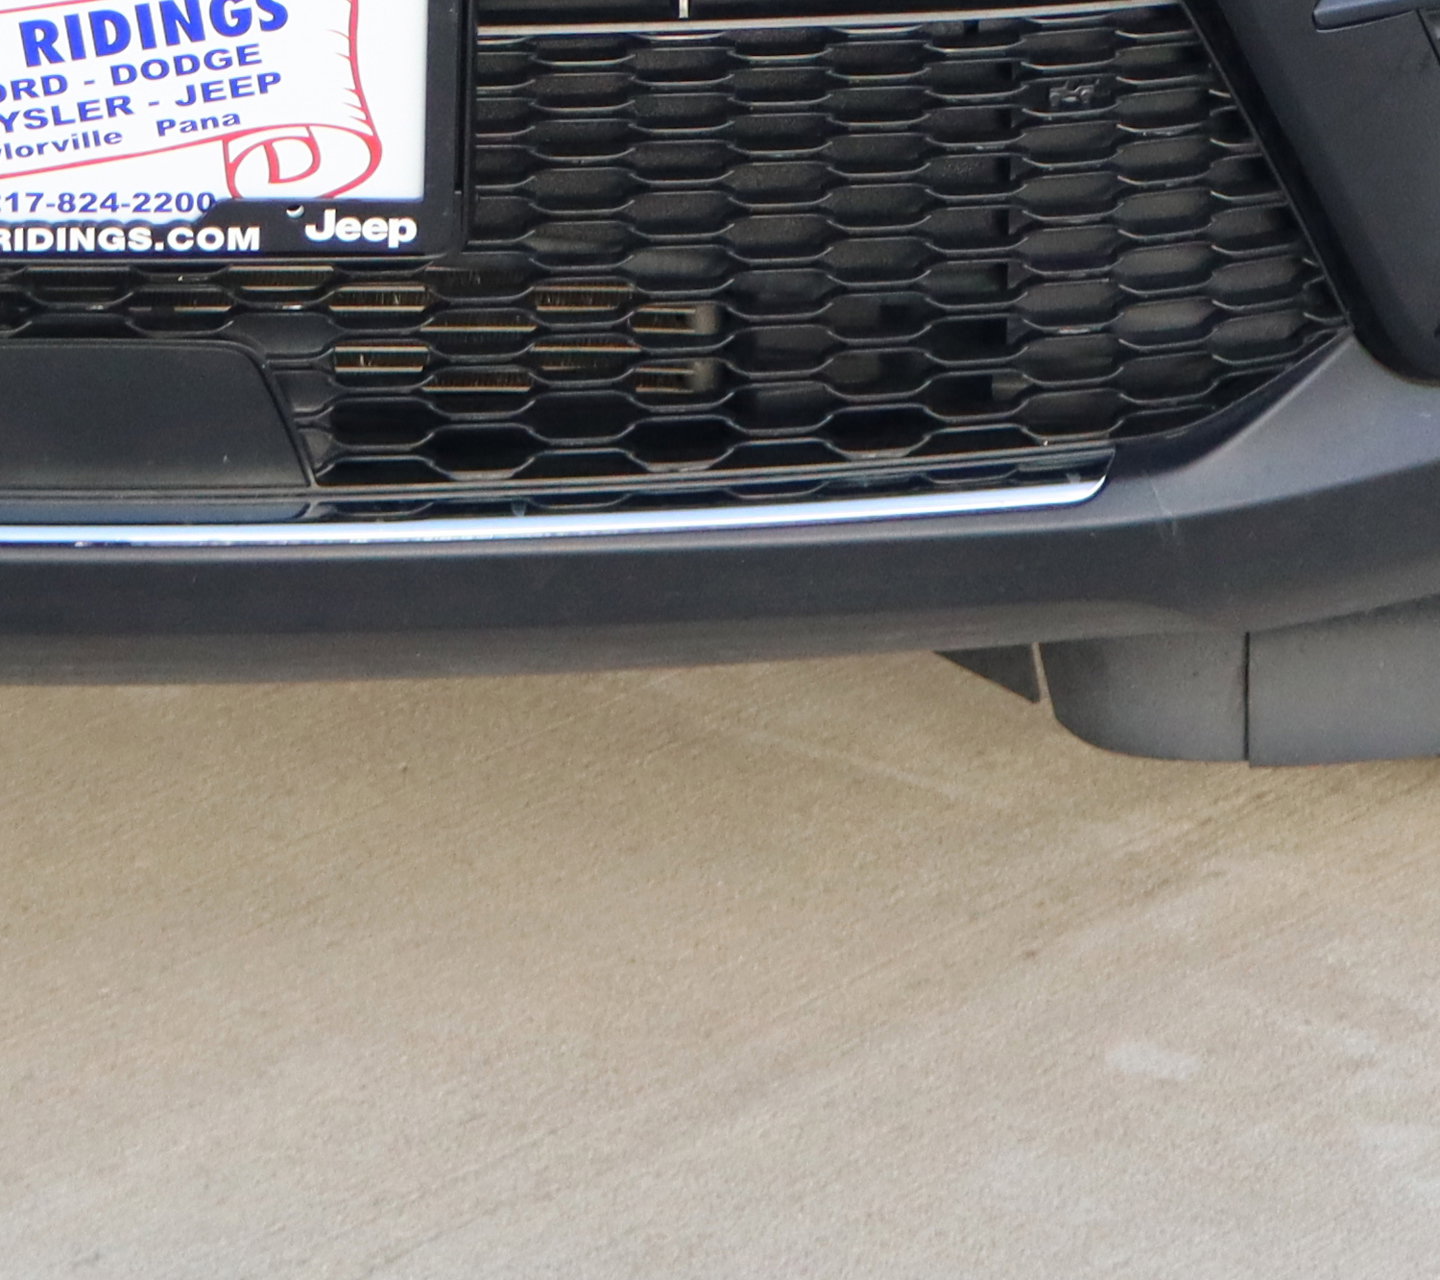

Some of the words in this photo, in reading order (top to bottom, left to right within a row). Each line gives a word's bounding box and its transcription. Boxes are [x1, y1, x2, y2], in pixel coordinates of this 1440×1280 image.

[110, 43, 262, 86] DODGE
[175, 72, 282, 107] JEEP
[156, 113, 241, 137] Pana
[304, 209, 418, 248] Jeep
